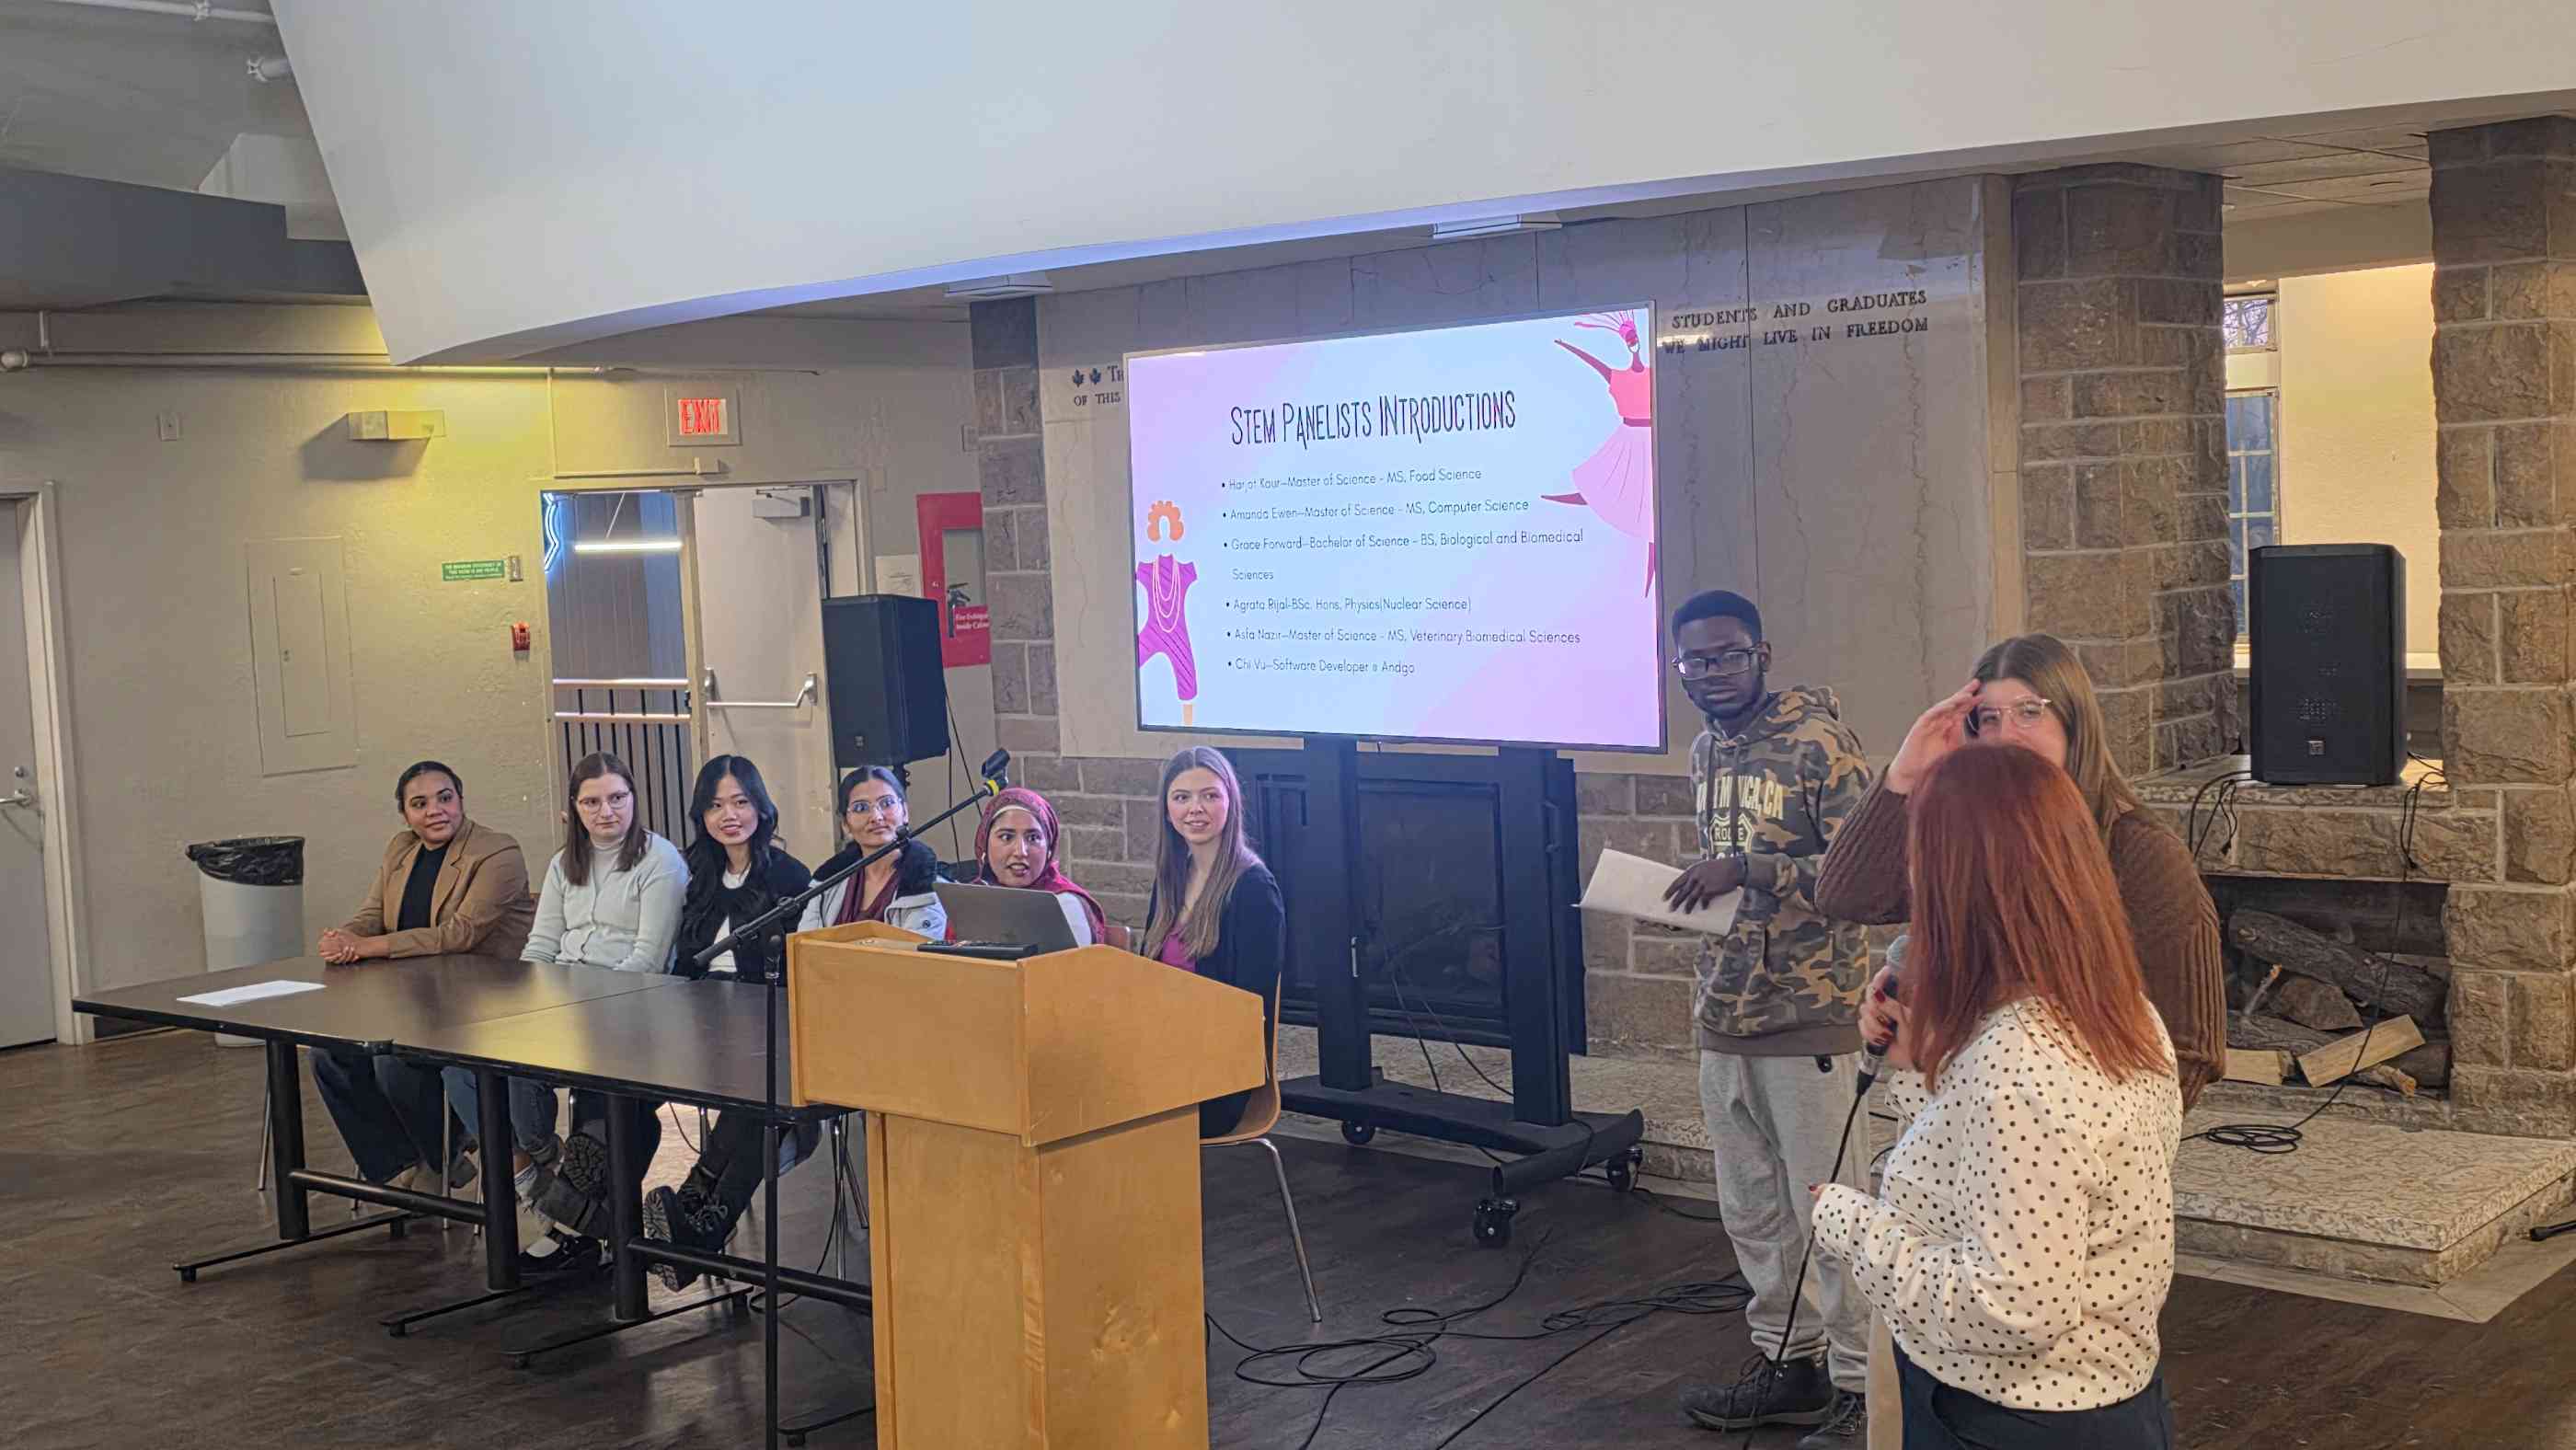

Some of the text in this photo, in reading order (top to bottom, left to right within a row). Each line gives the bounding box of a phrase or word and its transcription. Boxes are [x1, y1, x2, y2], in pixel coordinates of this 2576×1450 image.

[1672, 290, 1927, 329] STUDENTS AND GRADUATES
[1662, 317, 1928, 354] WE MIGHT LIVE IN FREEDOM
[1074, 392, 1121, 406] OF THIS
[679, 398, 721, 434] EXIT
[1230, 406, 1277, 445] STEM
[1282, 401, 1372, 450] PANELISTS
[1323, 472, 1333, 486] of
[1337, 473, 1376, 486] Science
[1409, 469, 1435, 482] Food
[1438, 467, 1482, 481] Science
[1230, 508, 1269, 520] Amanda
[1340, 502, 1351, 516] of
[1354, 503, 1395, 515] Science
[1428, 500, 1481, 515] Computer
[1484, 499, 1529, 512] Science
[1231, 538, 1260, 550] Grace
[1355, 533, 1365, 547] of
[1368, 534, 1409, 547] Science
[1441, 530, 1493, 548] Biological
[1496, 531, 1517, 544] and
[1521, 528, 1583, 544] Biomedical
[1232, 568, 1274, 581] Sciences
[1233, 599, 1265, 613] Agrata
[1324, 627, 1333, 640] of
[1337, 628, 1377, 641] Science
[1410, 629, 1463, 645] Veterinary
[1466, 627, 1525, 642] Biomedical
[1529, 629, 1581, 643] Sciences
[1235, 658, 1251, 670] Chi
[1318, 659, 1369, 675] Developer
[1382, 661, 1415, 676] Andgo
[1764, 779, 1784, 820] CA
